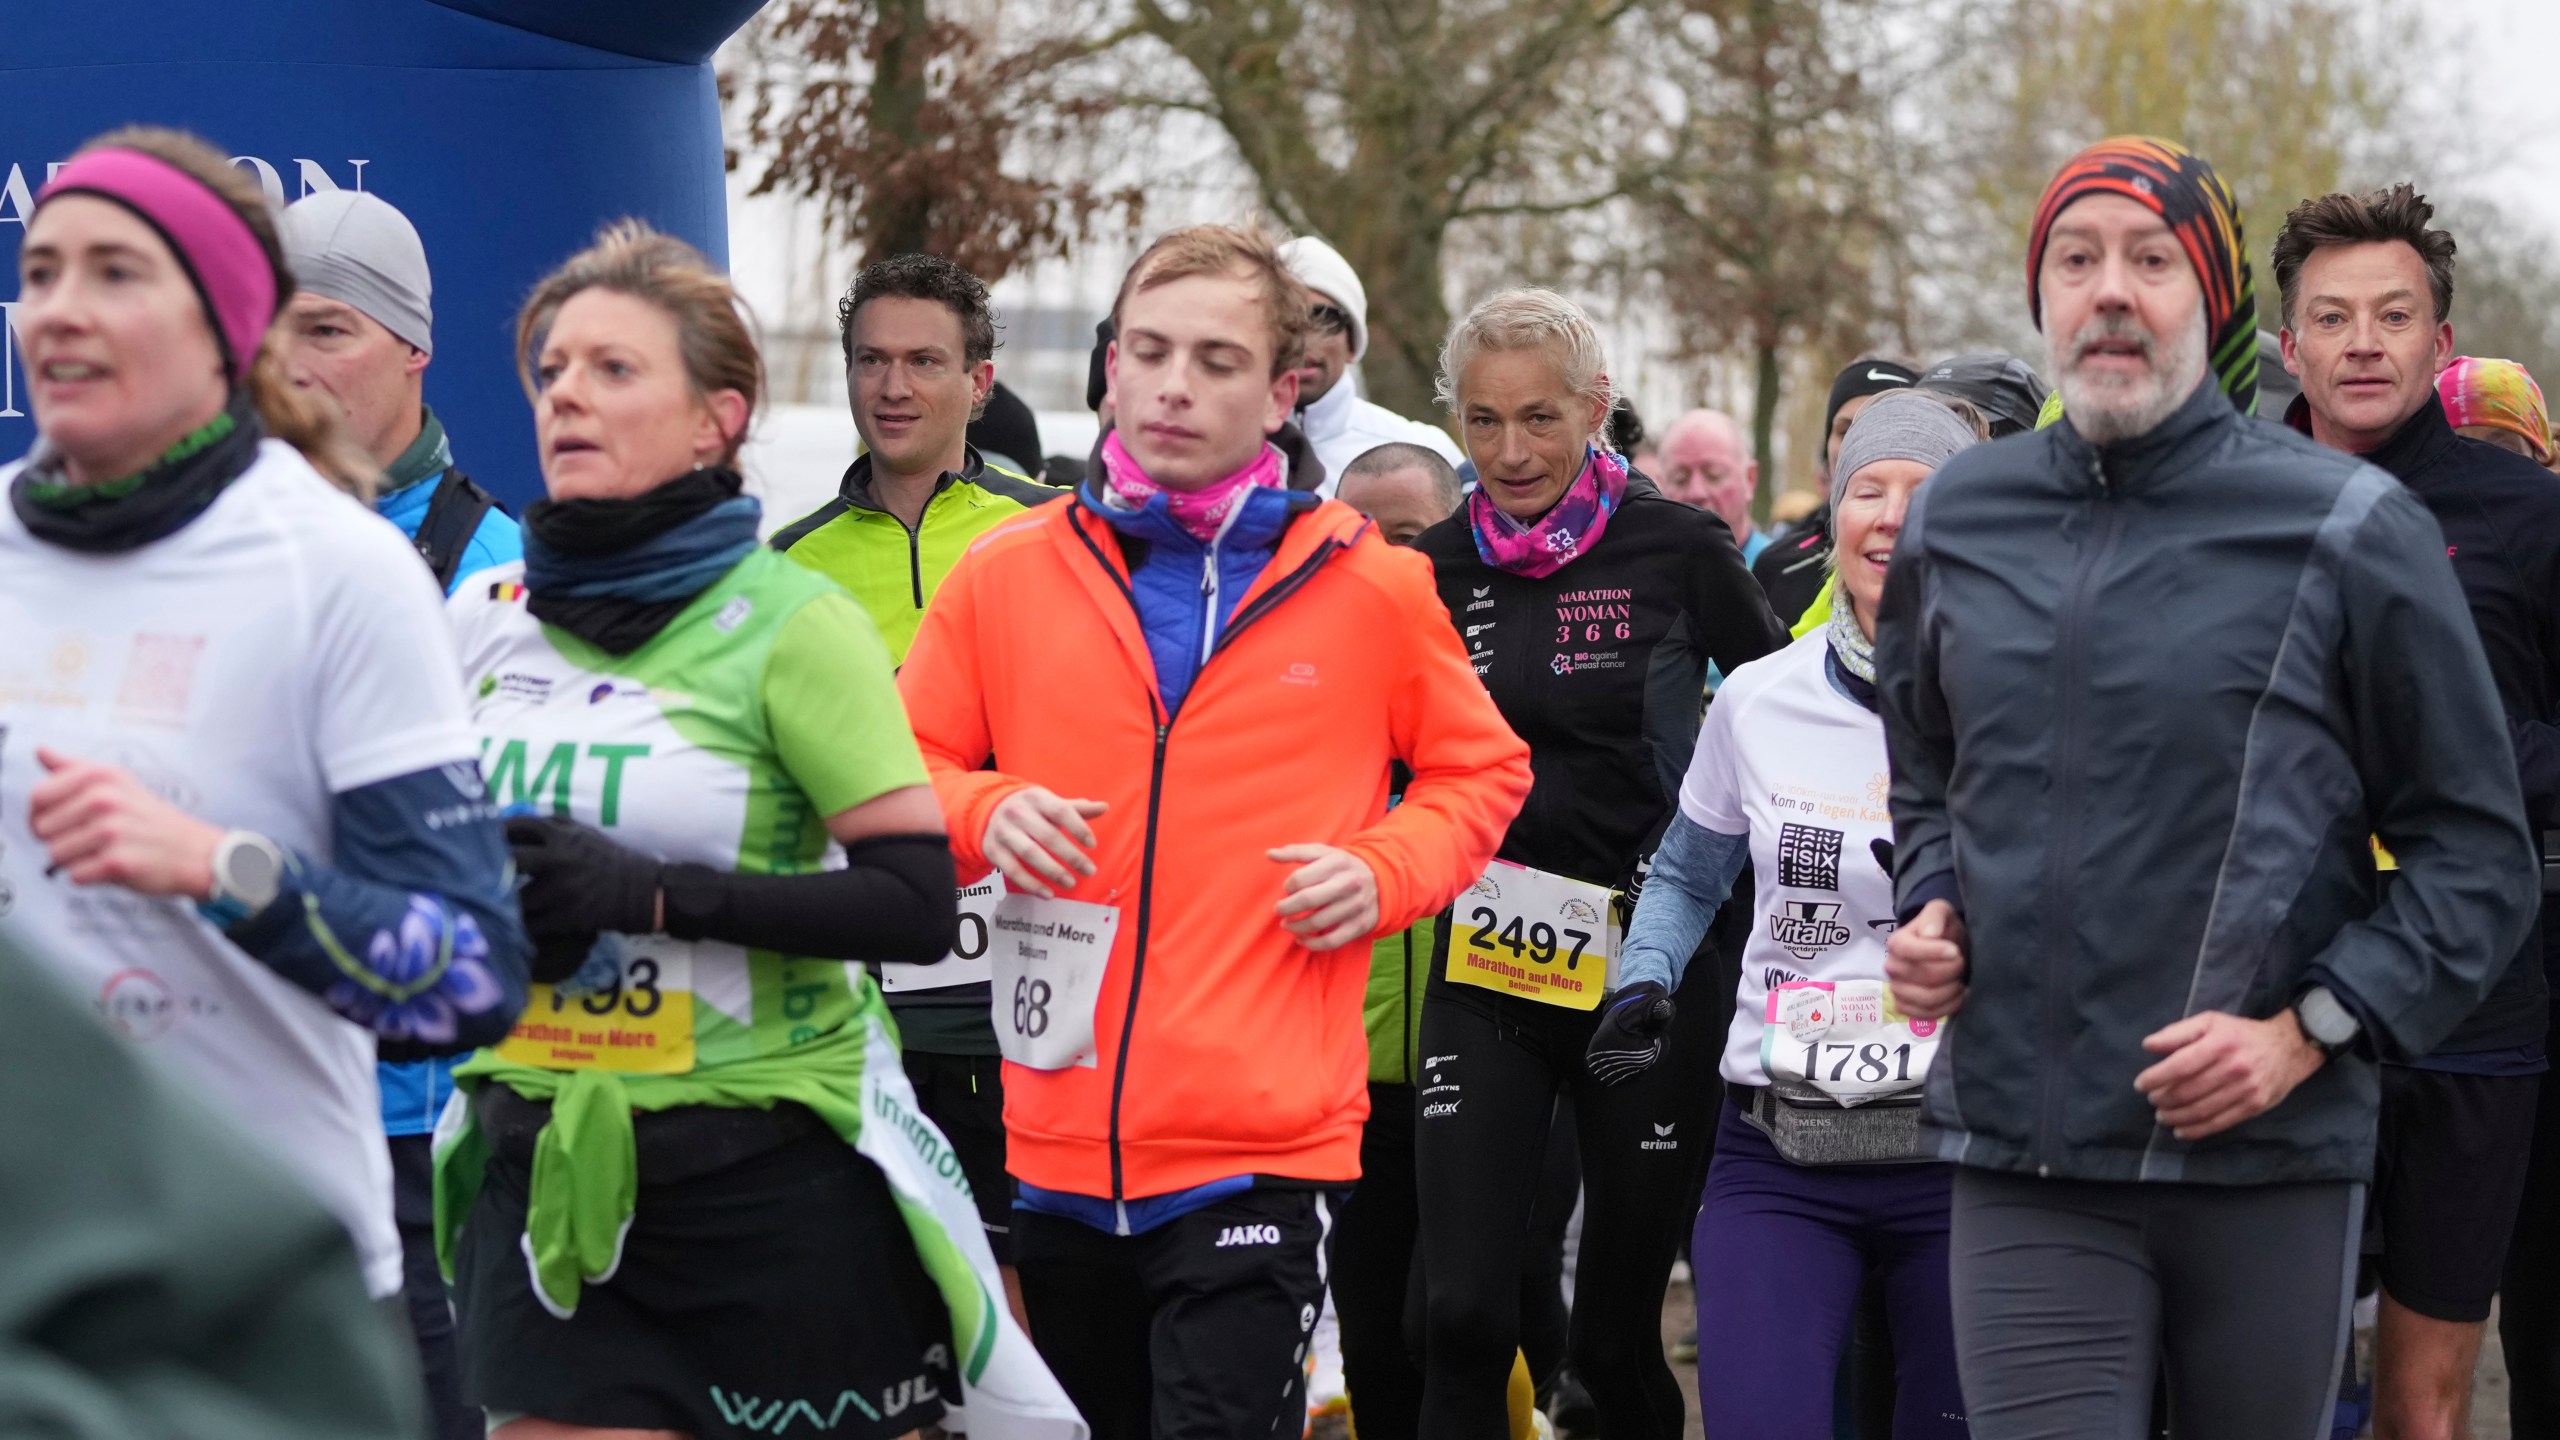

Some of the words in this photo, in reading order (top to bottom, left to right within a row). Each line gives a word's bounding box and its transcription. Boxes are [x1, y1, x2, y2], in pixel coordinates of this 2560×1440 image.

[1557, 589, 1632, 603] MARATHON
[1466, 599, 1495, 612] erima
[1556, 604, 1631, 623] WOMAN
[1556, 626, 1570, 643] 3
[1585, 623, 1600, 642] 6
[1615, 622, 1630, 639] 6
[1574, 652, 1589, 661] BIG
[1590, 651, 1618, 663] against
[1574, 661, 1599, 670] breast
[1600, 660, 1626, 669] cancer
[482, 738, 652, 829] MT
[1771, 792, 1796, 809] Kom
[1799, 800, 1815, 815] op
[1818, 800, 1856, 820] tegen
[1859, 807, 1892, 823] Kank
[956, 884, 993, 900] gium
[1057, 922, 1096, 945] More
[1469, 906, 1592, 970] 2497
[1770, 914, 1851, 946] Vitalic
[1783, 944, 1828, 952] sportdrinks
[1467, 952, 1526, 980] Marathon
[1528, 971, 1548, 985] and
[1550, 972, 1583, 992] More
[552, 957, 661, 1018] 93
[1508, 979, 1541, 995] Belgium
[1014, 975, 1052, 1039] 68
[1840, 1003, 1877, 1012] WOMAN
[1842, 1013, 1849, 1023] 3
[1855, 1012, 1863, 1023] 6
[1869, 1012, 1877, 1023] 6
[1916, 1020, 1931, 1028] YOU
[509, 1023, 573, 1043] arathon
[608, 1029, 656, 1048] More
[1801, 1041, 1912, 1083] 1781
[1422, 1085, 1460, 1096] CHRISTEYNS
[1793, 1118, 1832, 1128] EMENS
[1640, 1138, 1678, 1150] erima
[1215, 1224, 1281, 1247] JAKO
